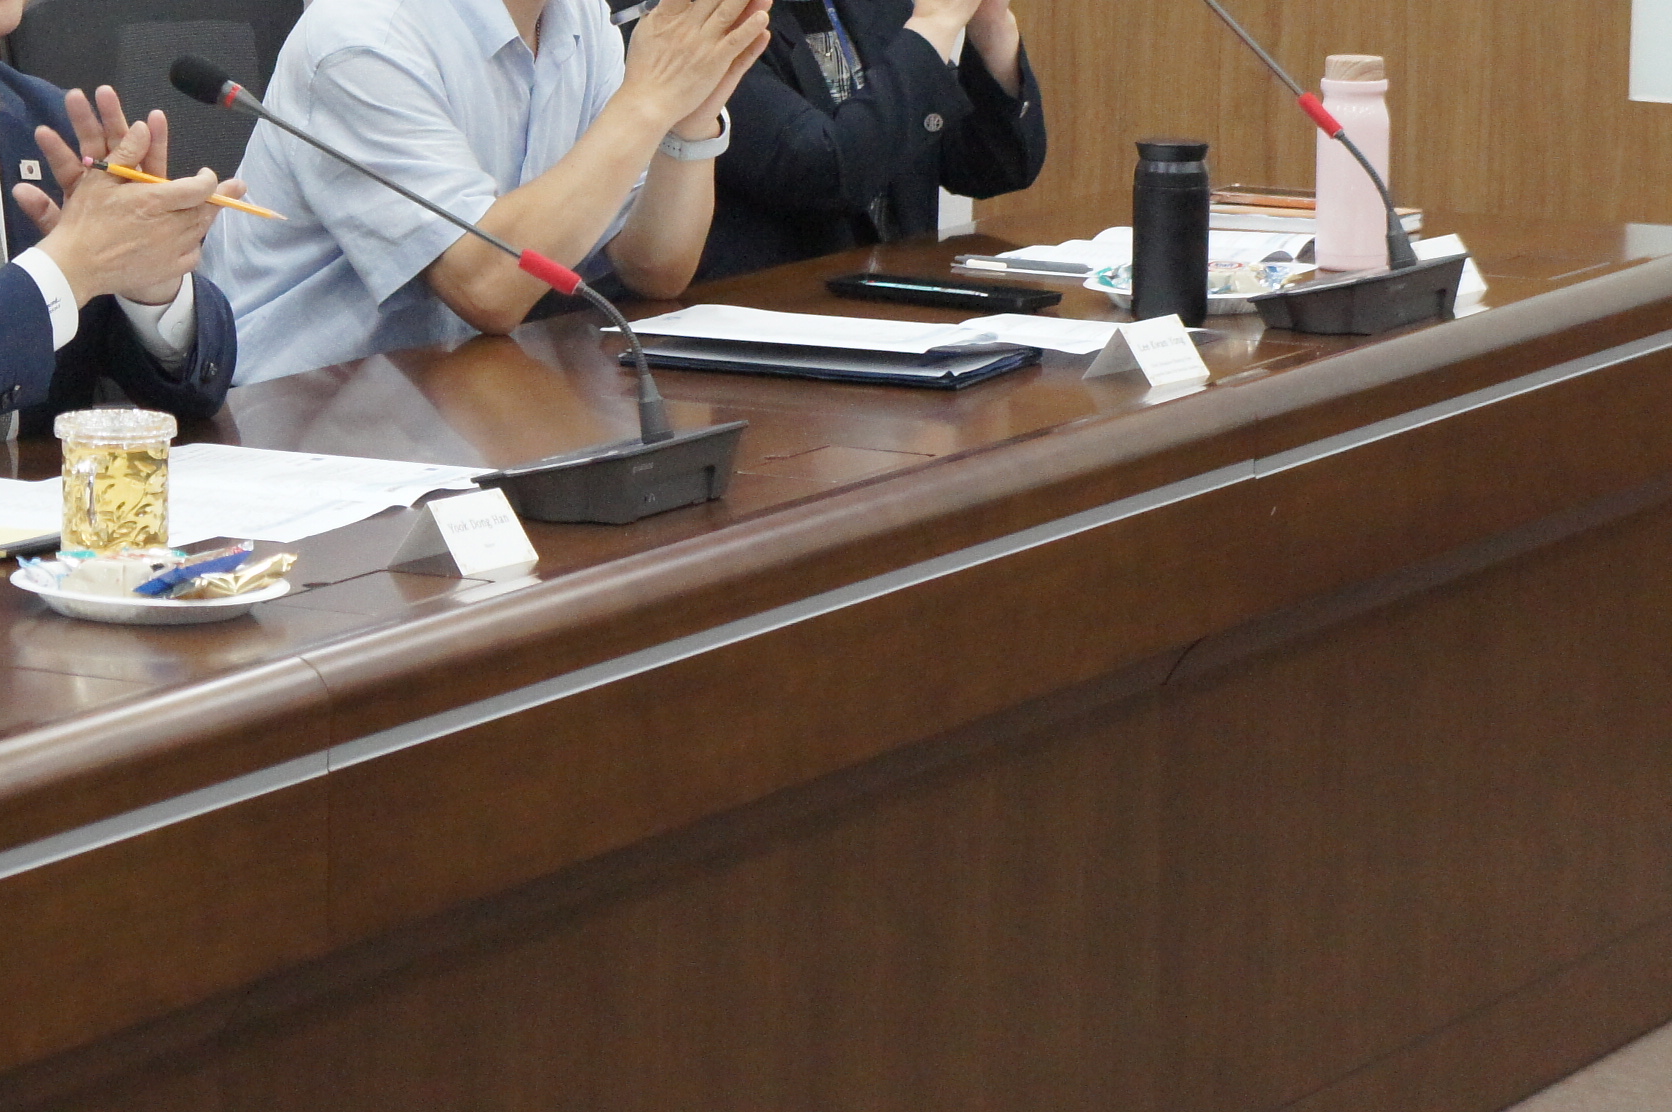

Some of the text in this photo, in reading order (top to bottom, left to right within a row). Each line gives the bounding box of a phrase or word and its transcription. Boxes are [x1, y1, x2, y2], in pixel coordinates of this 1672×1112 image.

[447, 514, 510, 534] Yook Dong Han
